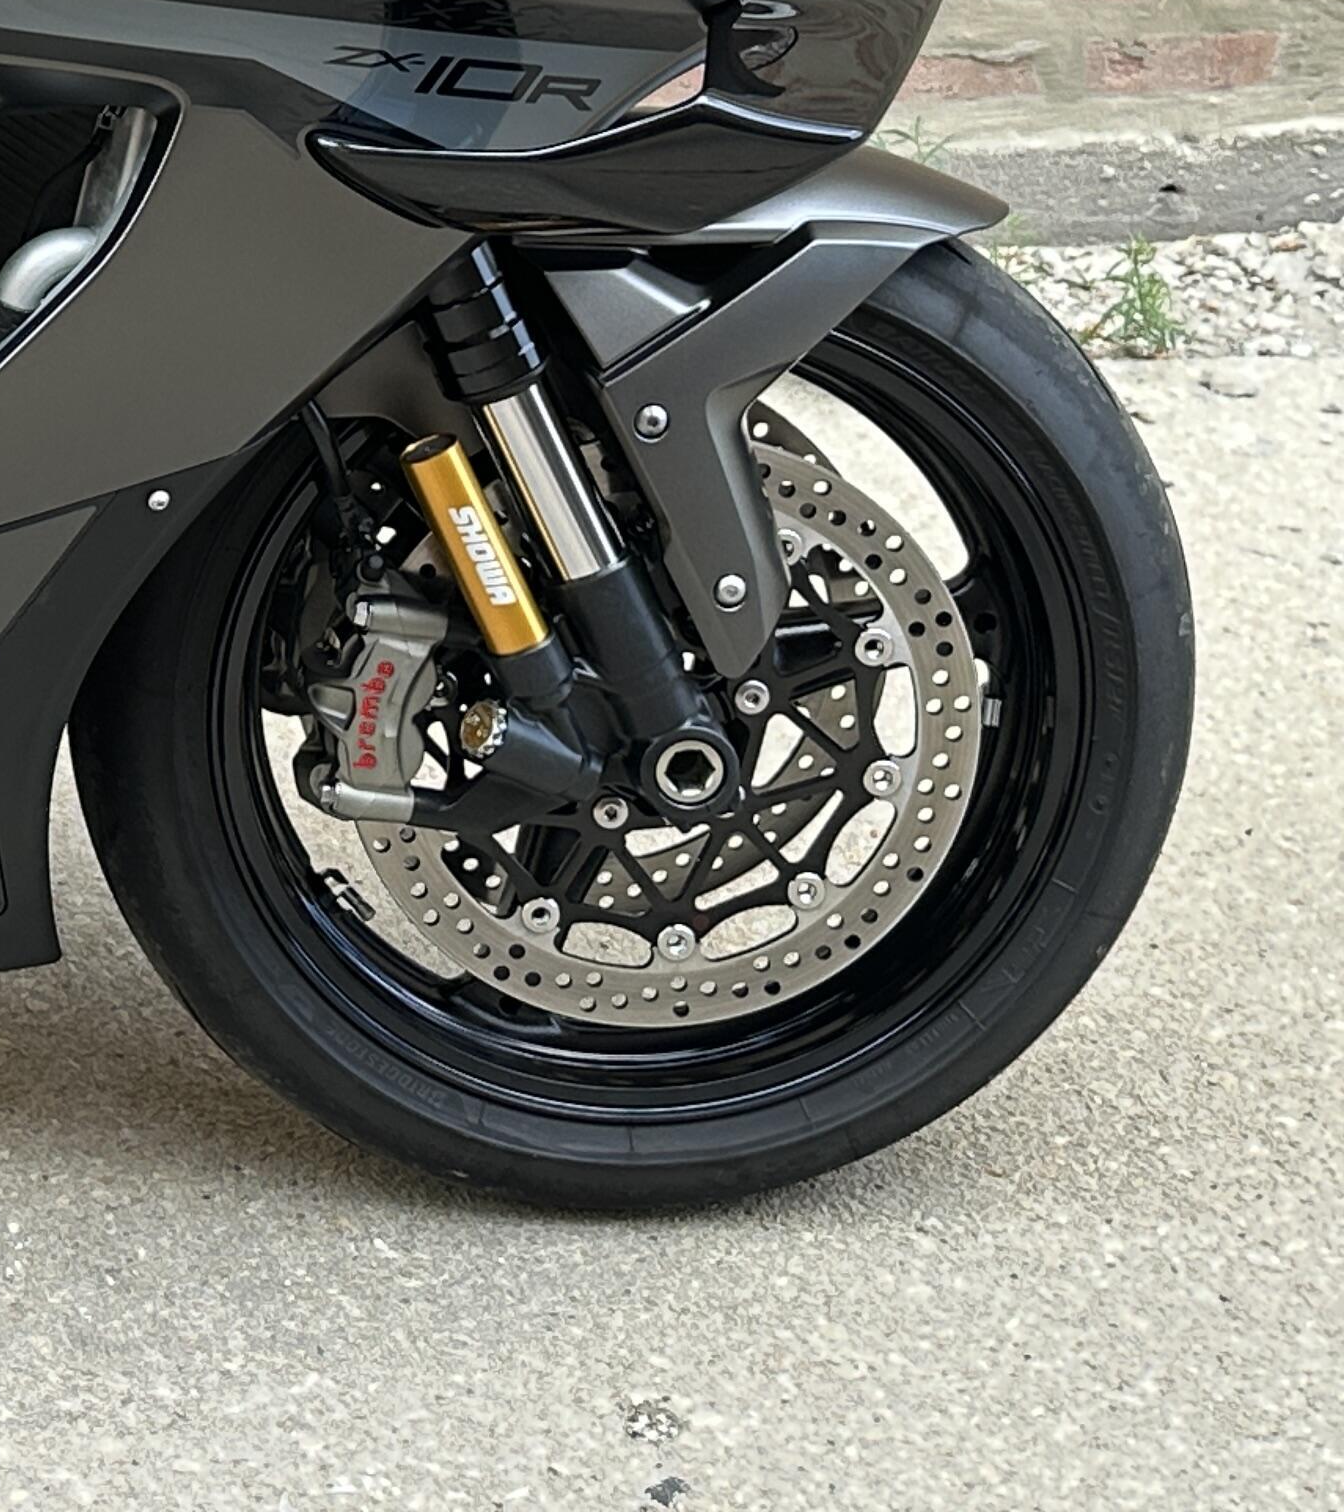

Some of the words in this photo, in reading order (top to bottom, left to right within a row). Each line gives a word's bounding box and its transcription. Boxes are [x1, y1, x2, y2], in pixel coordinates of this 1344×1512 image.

[323, 45, 602, 112] ZX-10R
[447, 505, 518, 606] SHOWA
[352, 660, 395, 770] brembo
